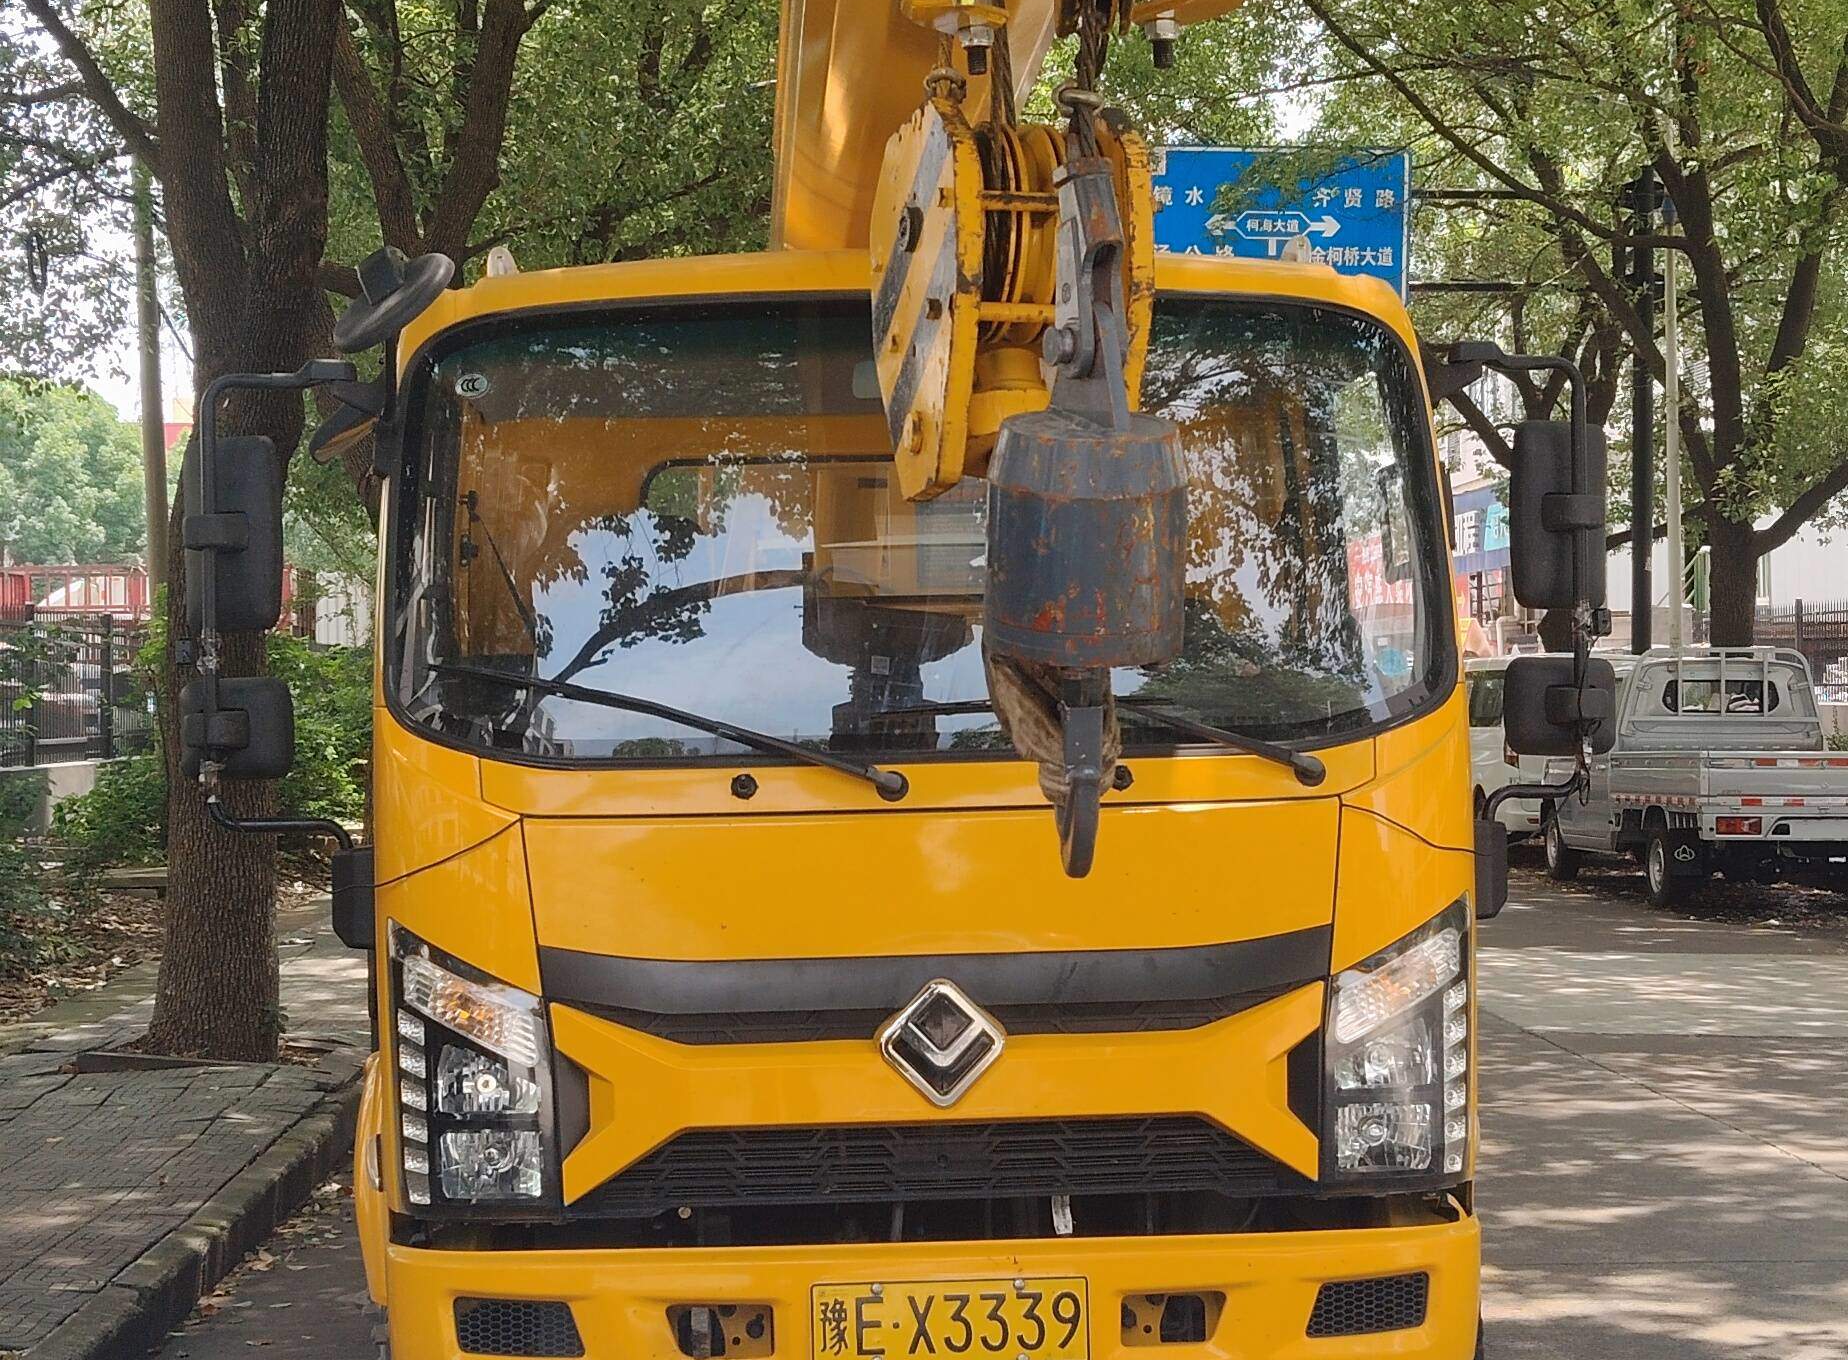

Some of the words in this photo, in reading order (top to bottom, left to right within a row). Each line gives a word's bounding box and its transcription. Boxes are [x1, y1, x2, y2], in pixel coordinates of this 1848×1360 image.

[1312, 187, 1396, 209] 齐贤路
[1310, 246, 1394, 267] 金柯桥大道
[818, 1290, 1082, 1357] 豫E·X3339
